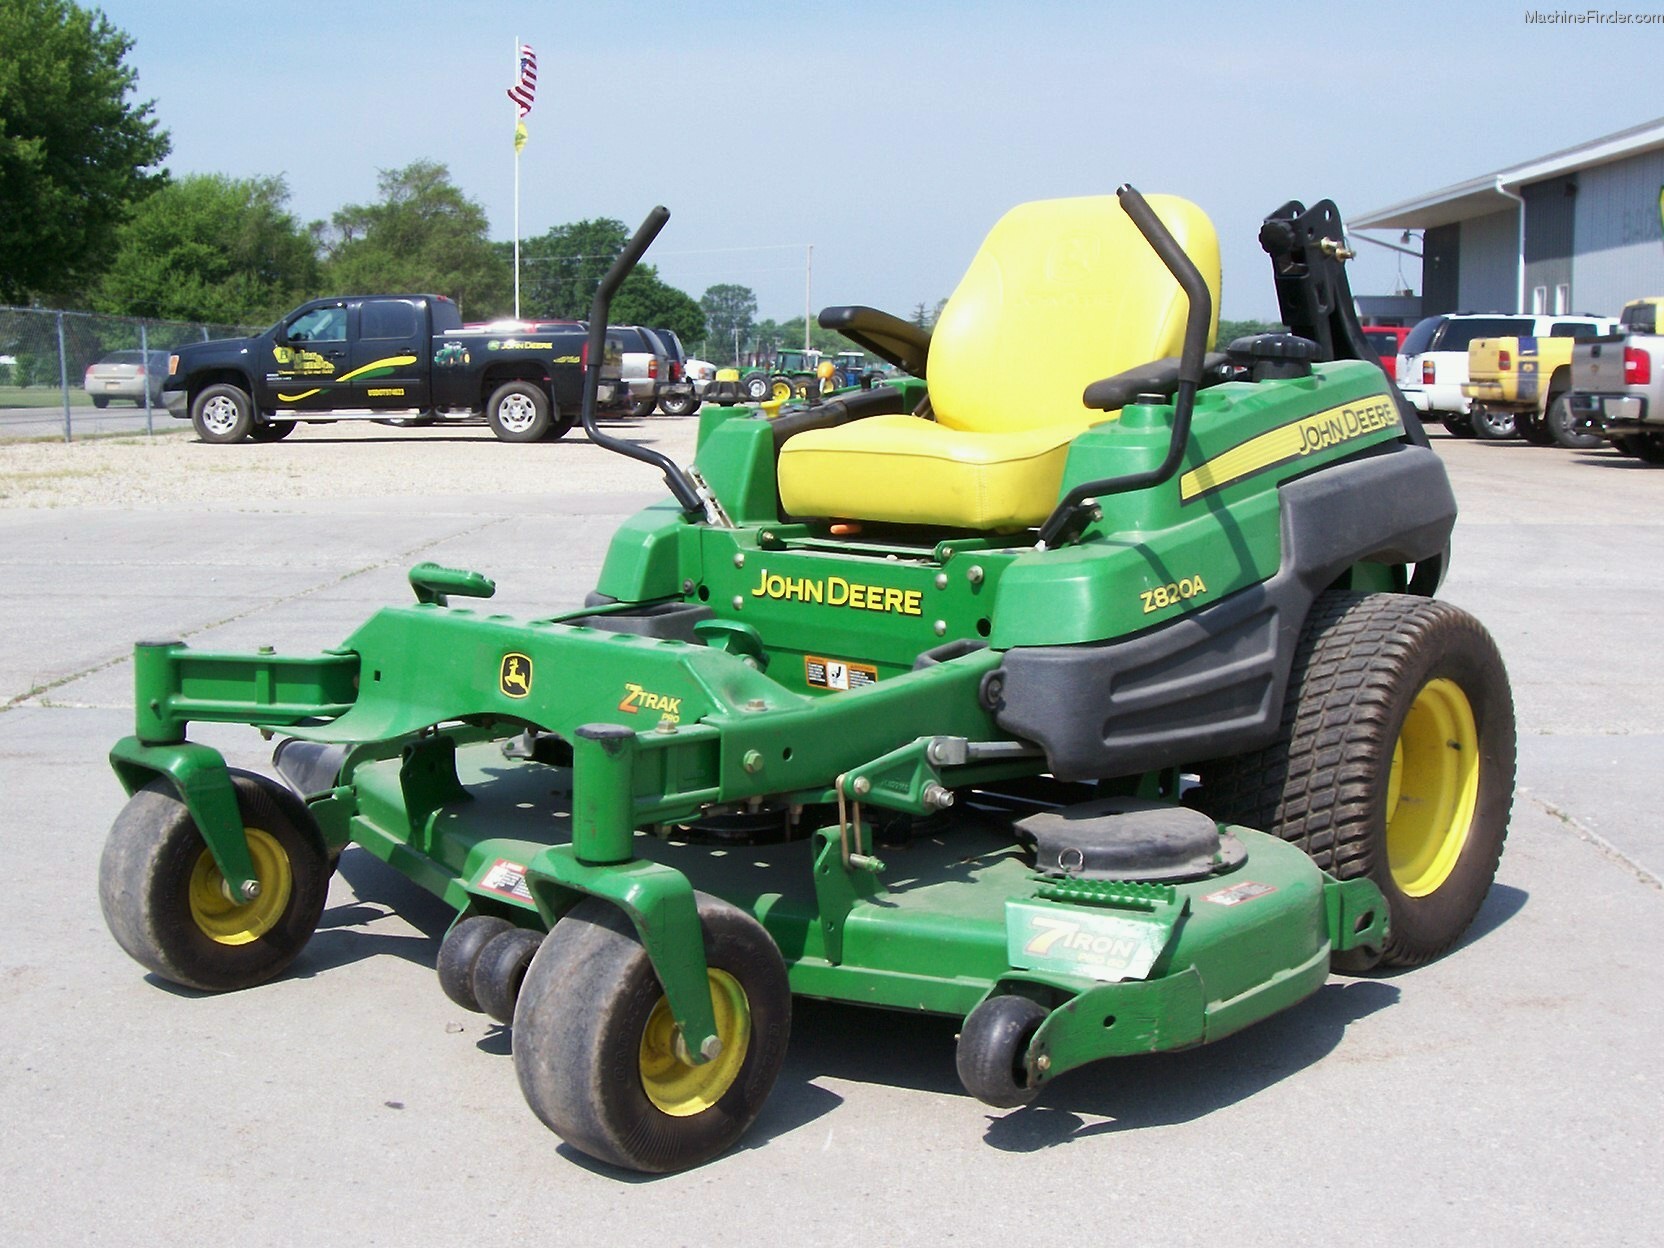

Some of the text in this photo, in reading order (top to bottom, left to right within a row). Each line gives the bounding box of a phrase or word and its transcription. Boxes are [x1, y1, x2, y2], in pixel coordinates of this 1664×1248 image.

[1299, 403, 1395, 452] JOHN DEERE
[752, 568, 922, 616] JOHN DEERE
[1139, 574, 1208, 615] Z820A
